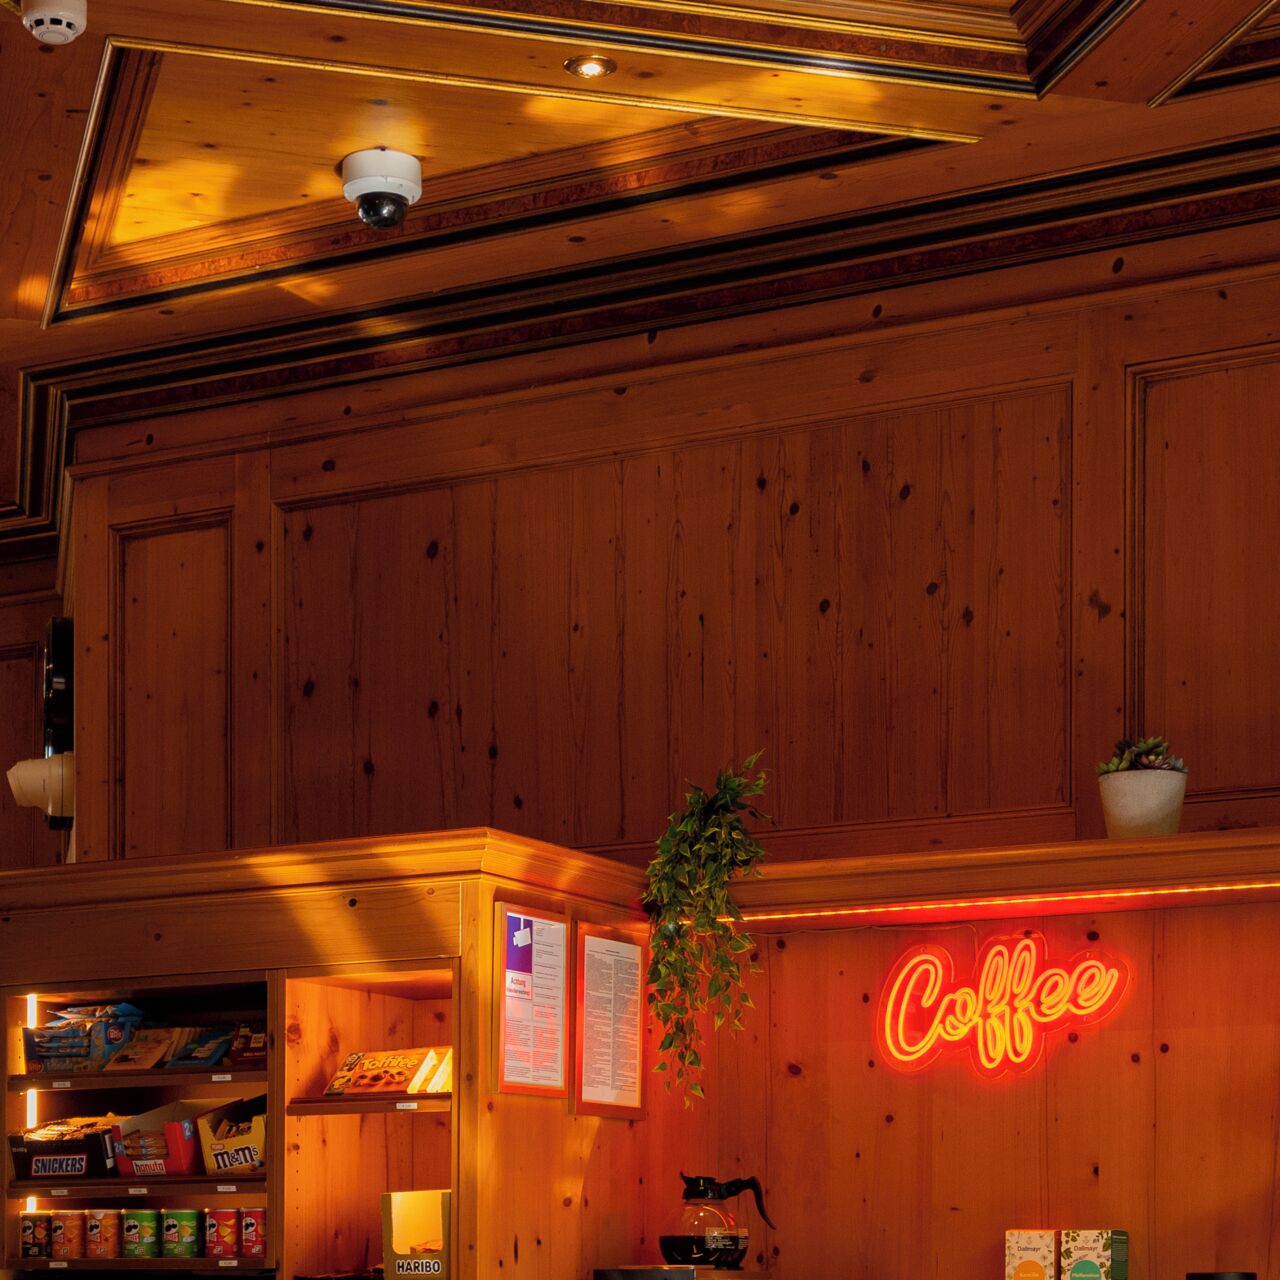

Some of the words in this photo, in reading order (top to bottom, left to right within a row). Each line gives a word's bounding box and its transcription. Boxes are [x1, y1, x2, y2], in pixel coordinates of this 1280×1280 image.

[884, 938, 1119, 1069] Coffee
[361, 1055, 419, 1070] Toffifee
[33, 1156, 85, 1174] SNICKERS
[134, 1161, 164, 1173] hanuta
[1017, 1245, 1041, 1253] Dallmayr
[1073, 1245, 1099, 1253] Dallmayr
[396, 1260, 441, 1274] HARIBO
